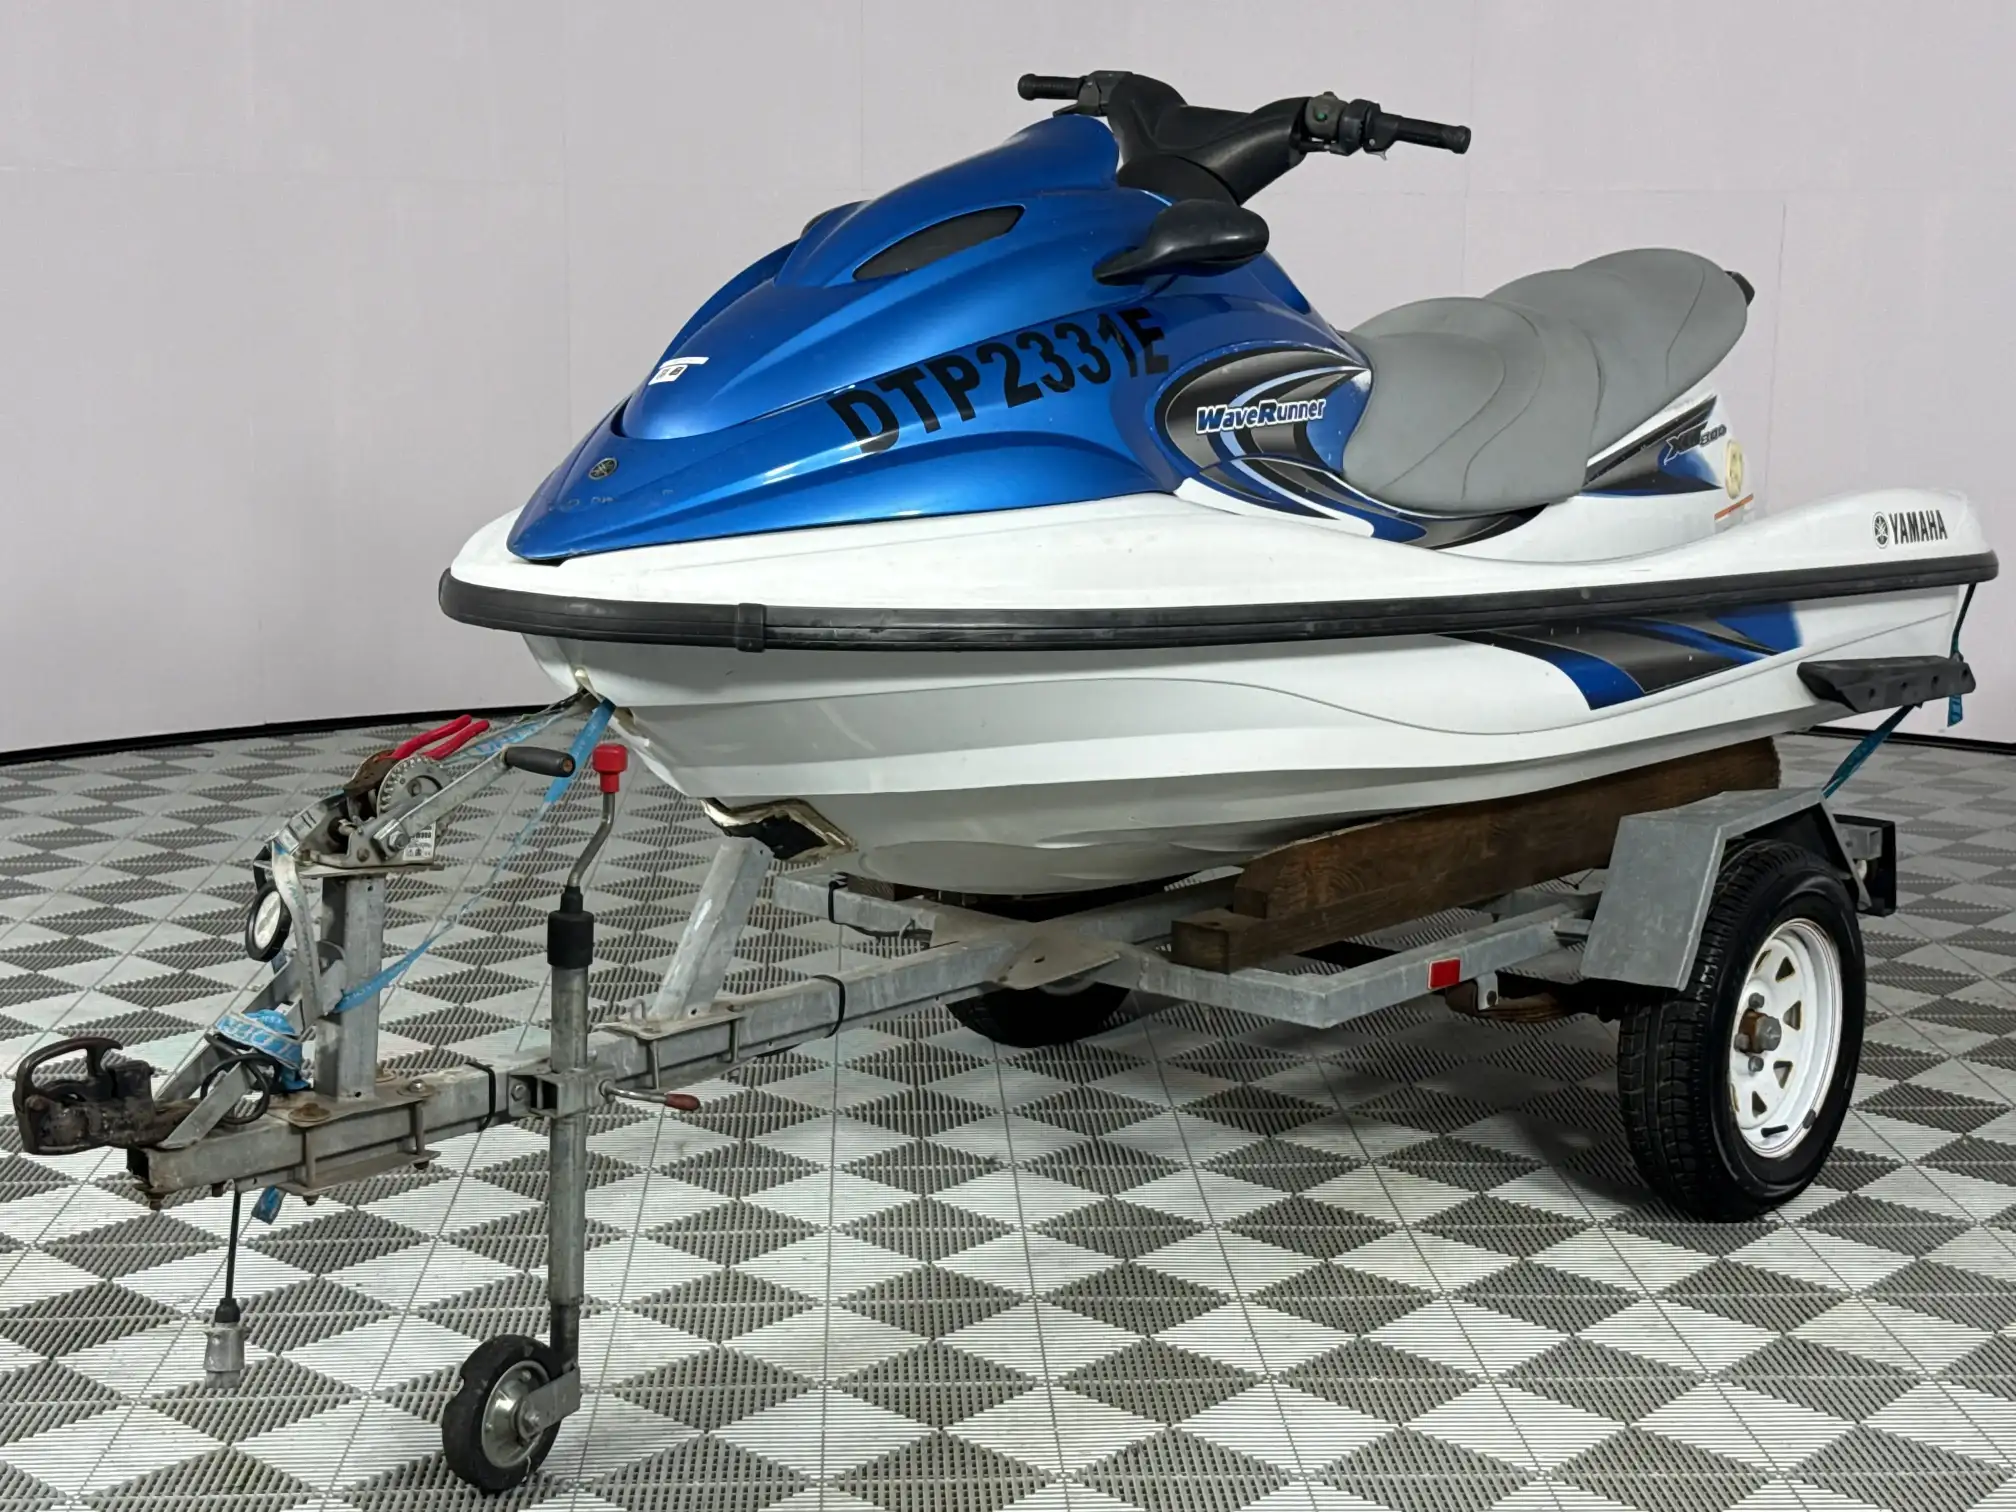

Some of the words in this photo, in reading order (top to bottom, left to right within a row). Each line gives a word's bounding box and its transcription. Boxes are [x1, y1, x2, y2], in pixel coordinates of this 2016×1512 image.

[826, 307, 1169, 454] DTP2331E
[1196, 399, 1327, 434] WaveRunner
[1888, 510, 1948, 545] YAMAHA
